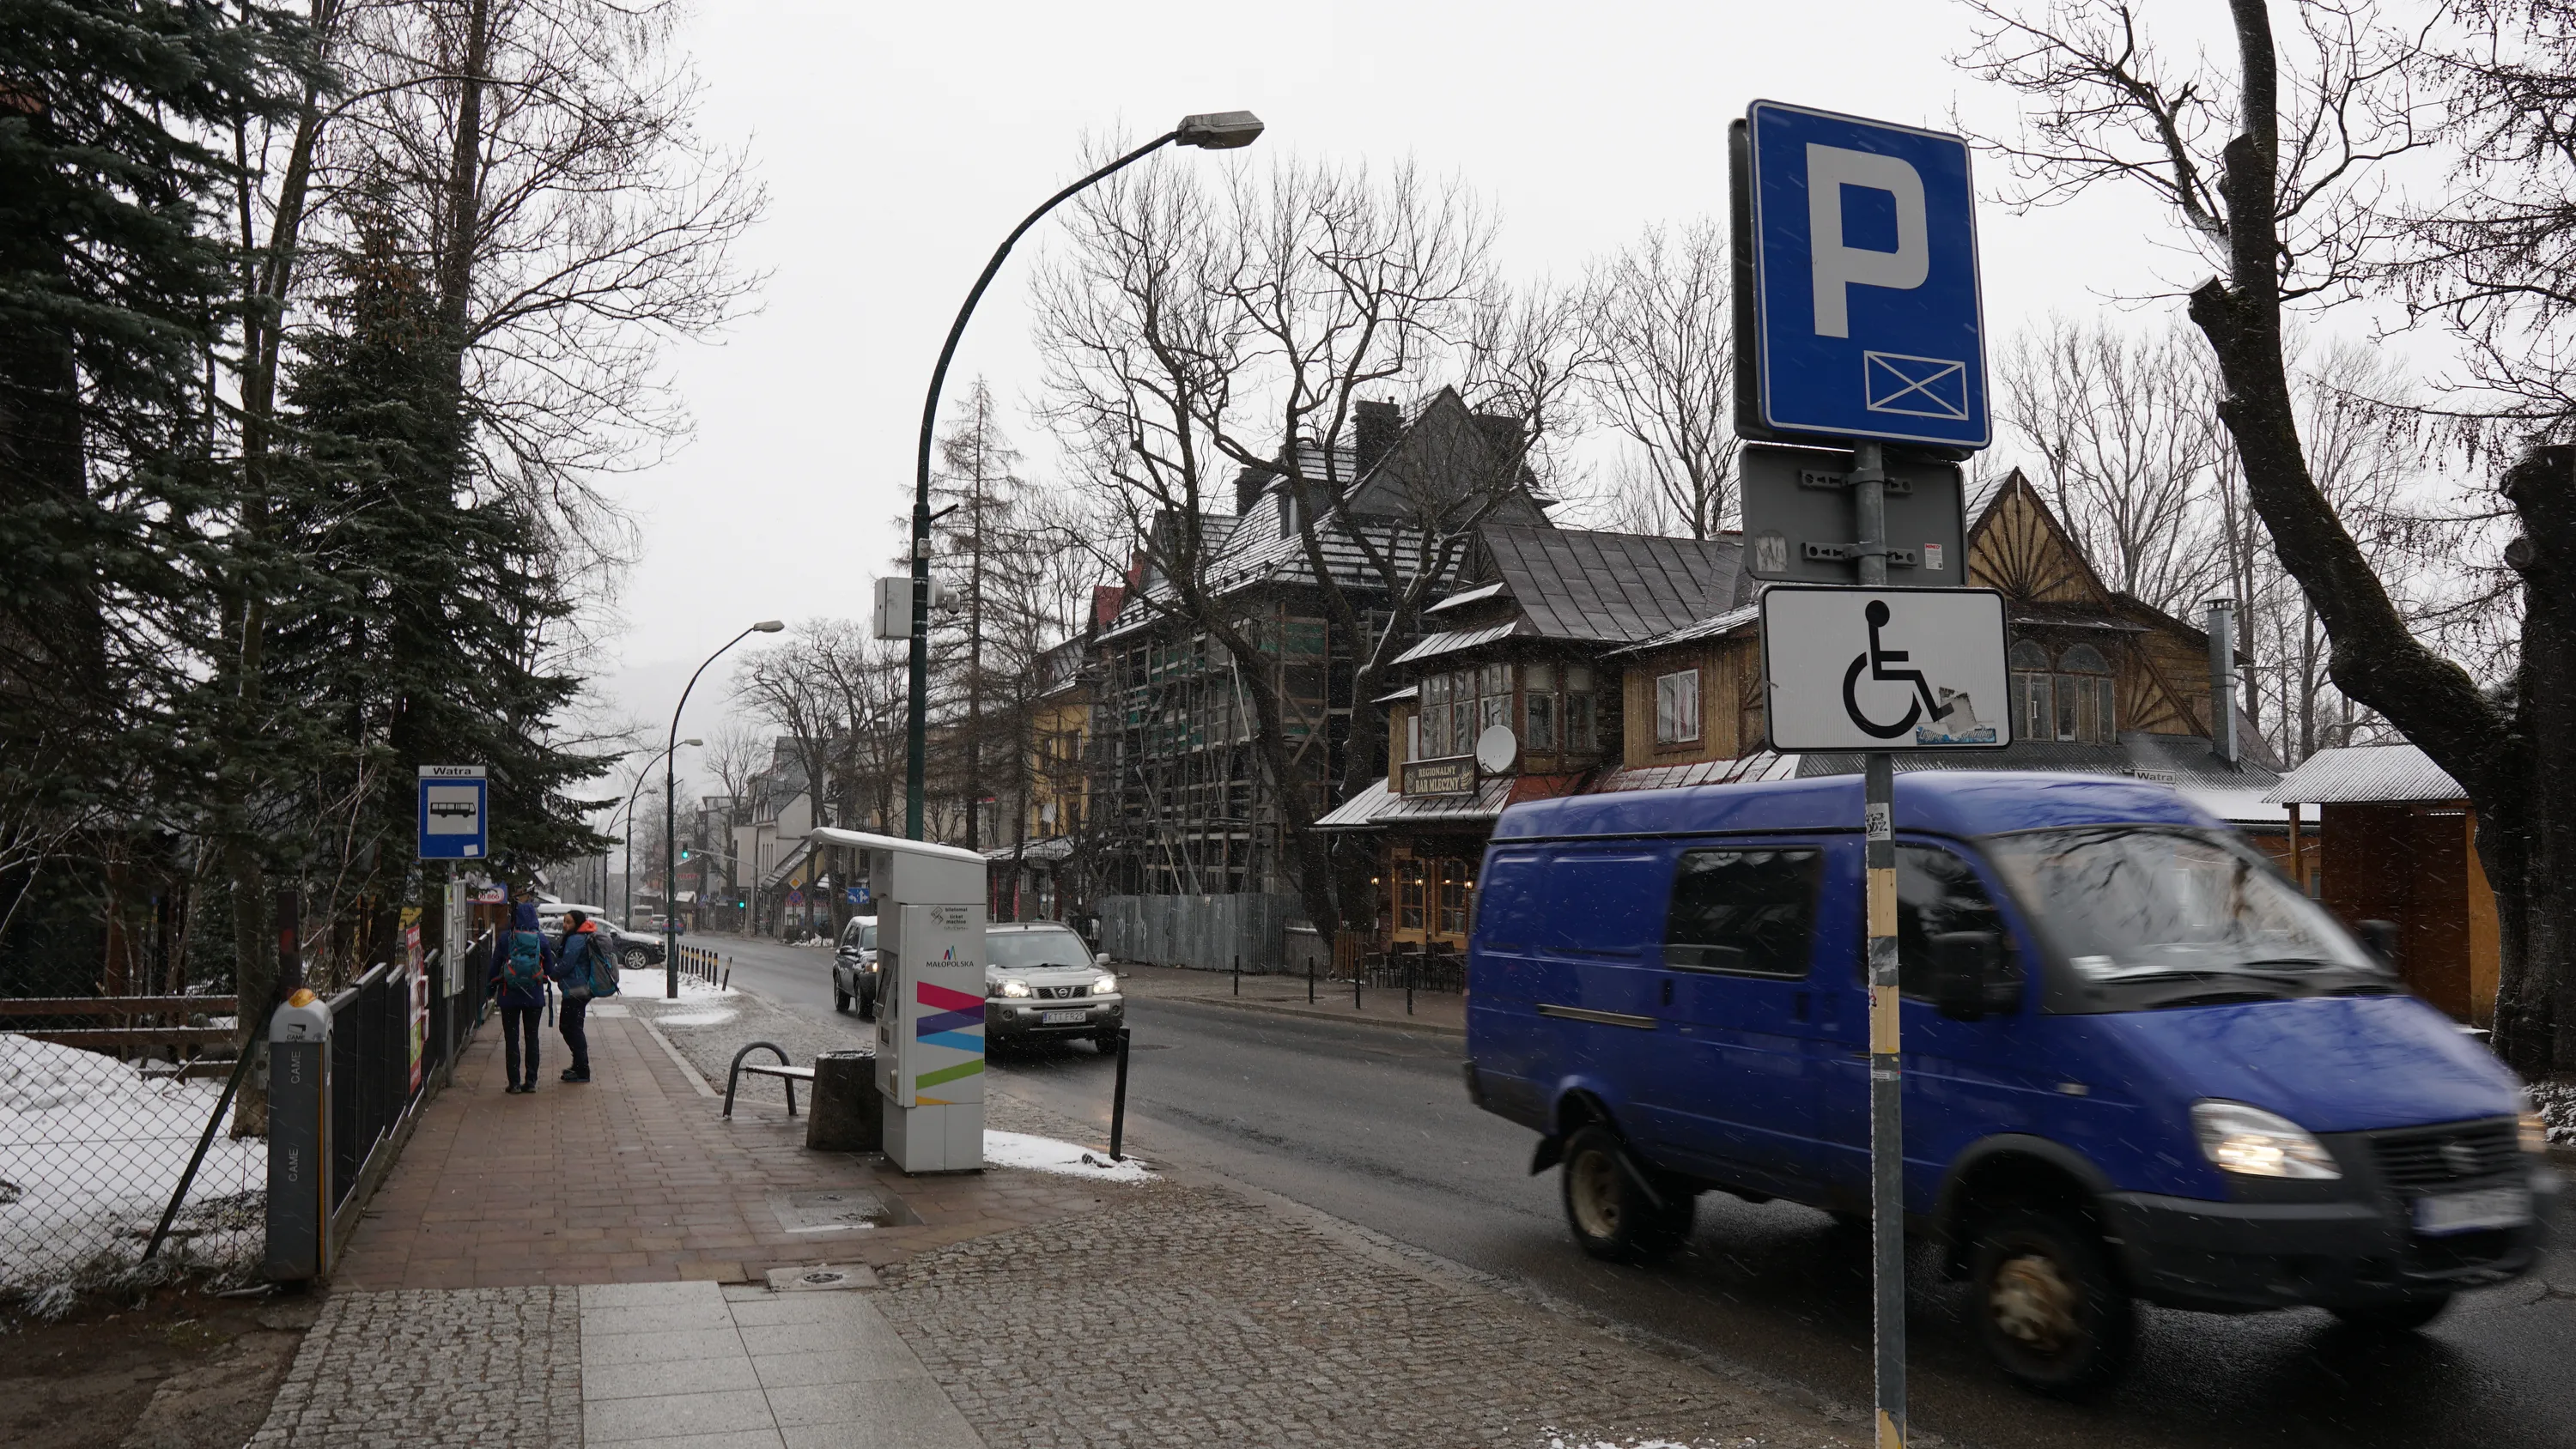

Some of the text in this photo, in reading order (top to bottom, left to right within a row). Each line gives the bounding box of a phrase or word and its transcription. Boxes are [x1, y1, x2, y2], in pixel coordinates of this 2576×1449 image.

[1807, 142, 1929, 338] P
[1415, 777, 1460, 793] BAR MLECZNY
[1419, 766, 1456, 778] REGIONALNY
[291, 1051, 301, 1084] CAME
[289, 1148, 299, 1182] CAME
